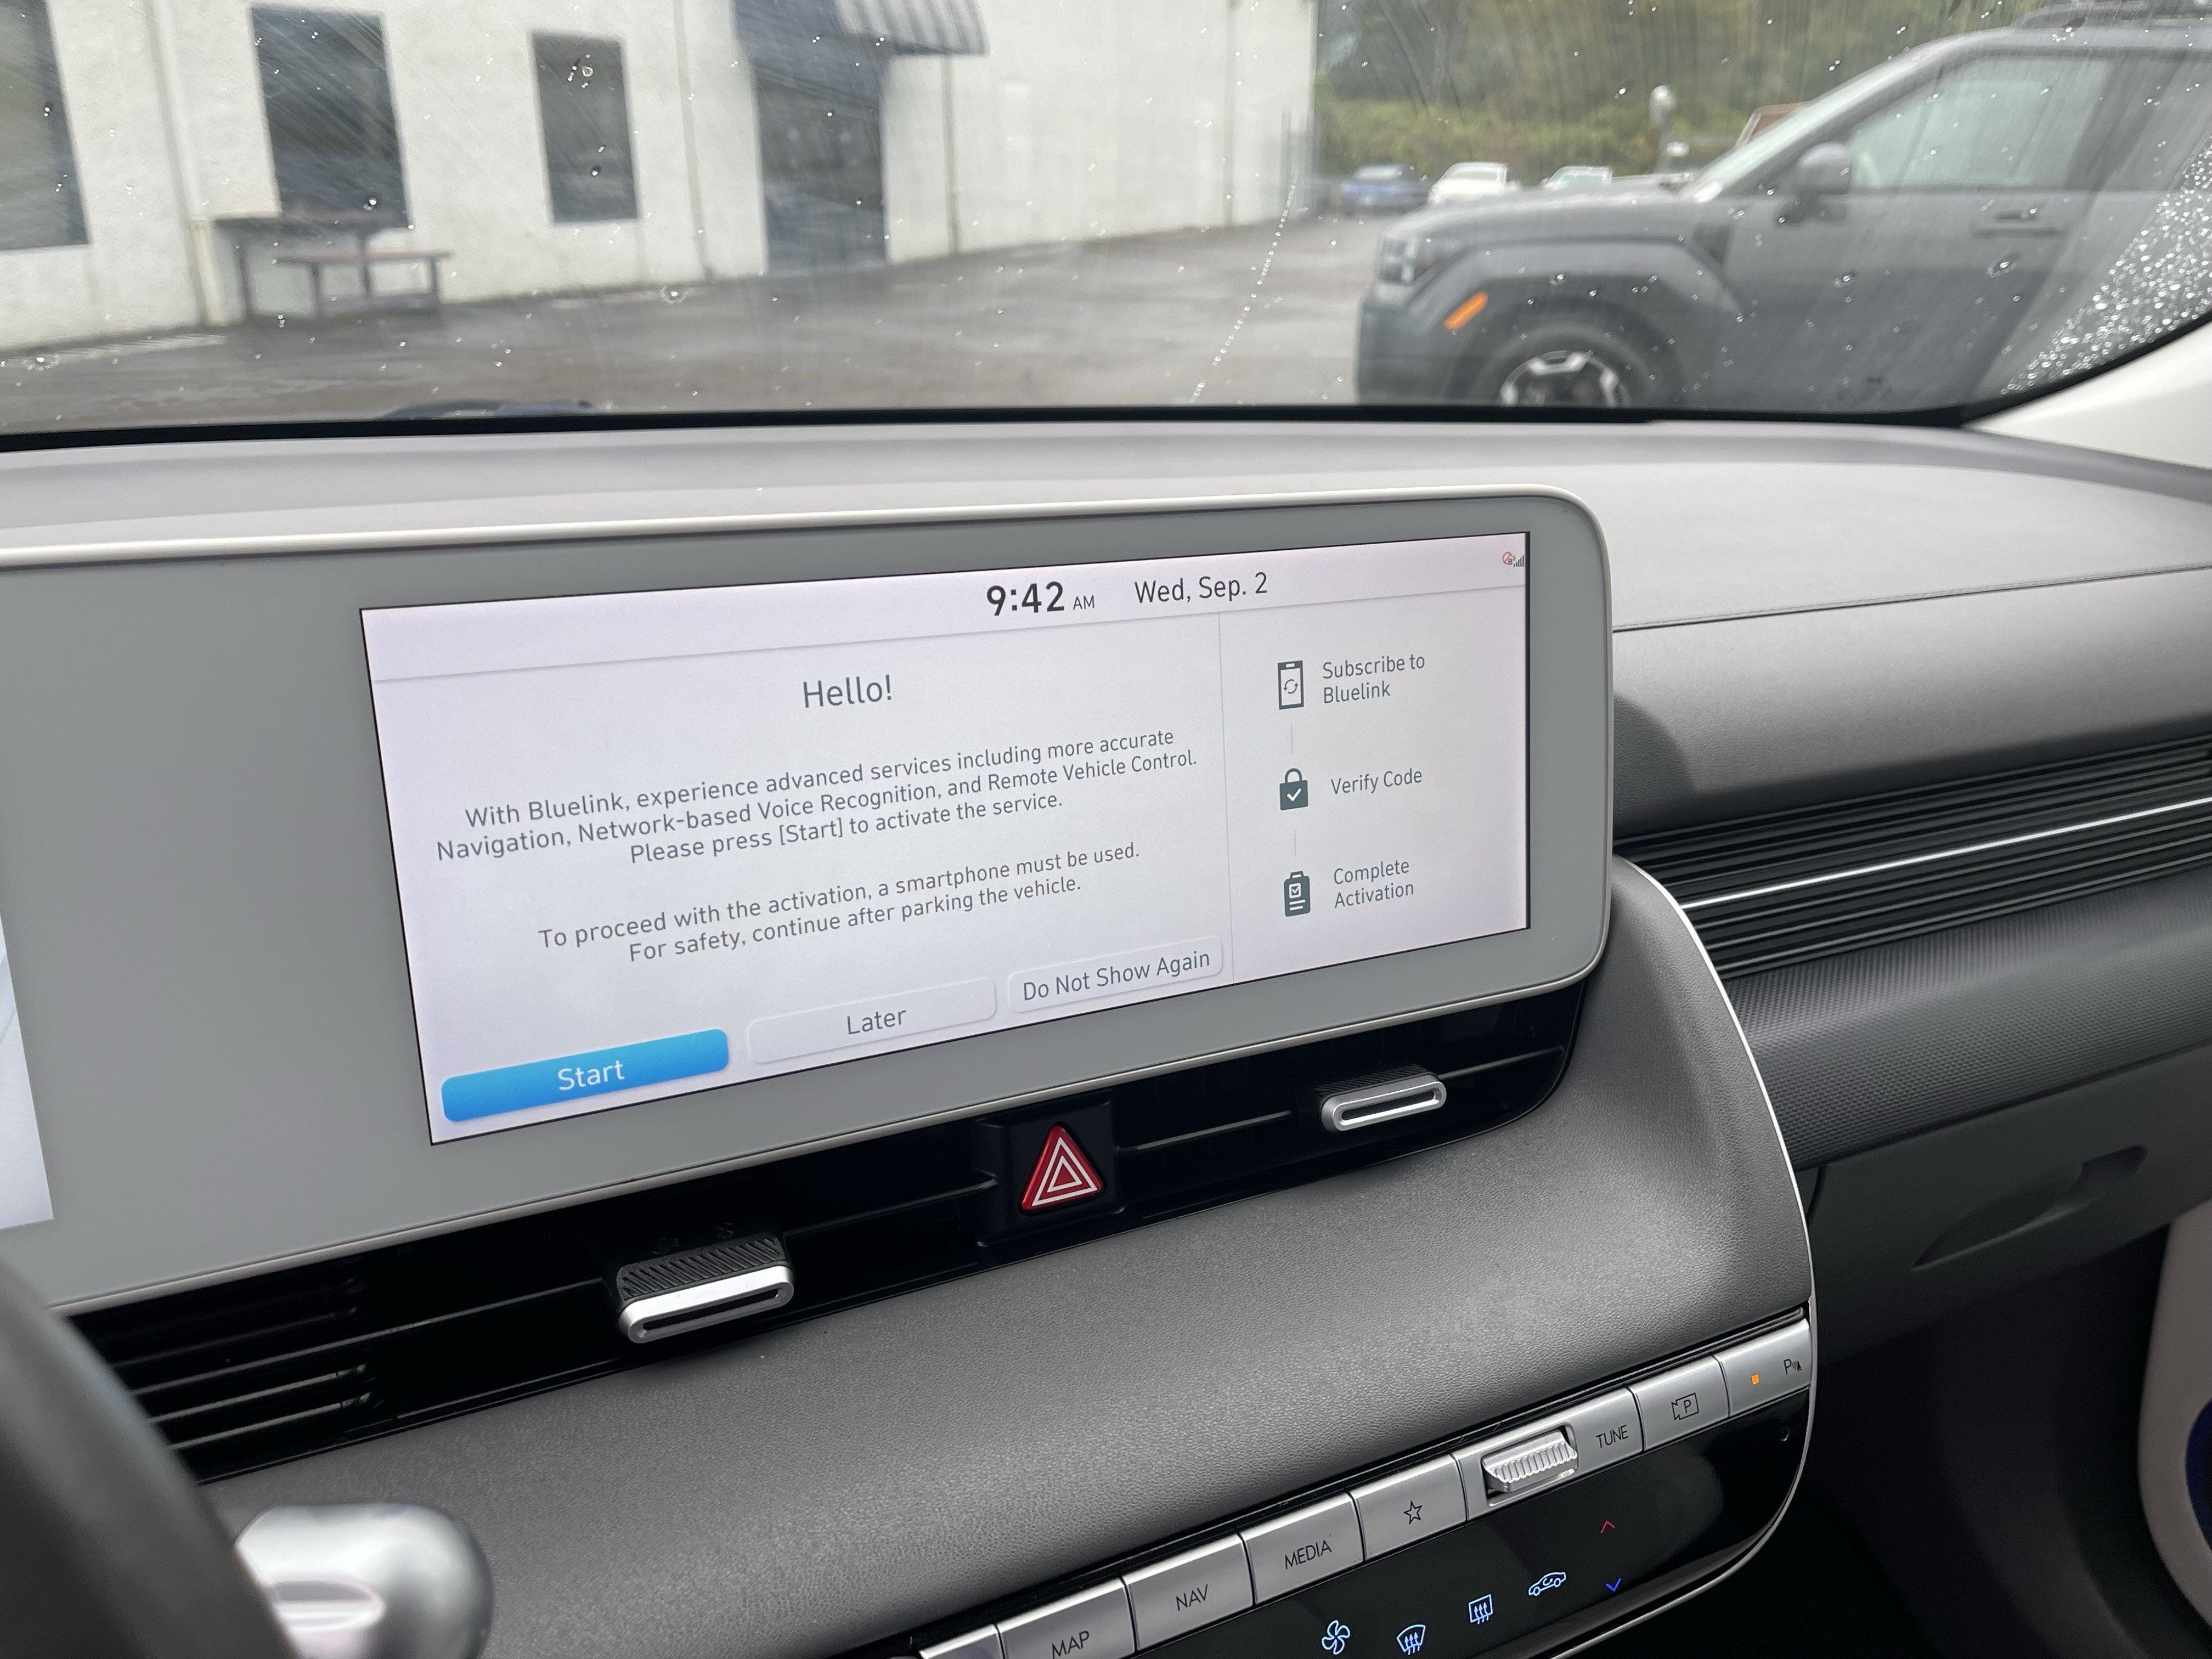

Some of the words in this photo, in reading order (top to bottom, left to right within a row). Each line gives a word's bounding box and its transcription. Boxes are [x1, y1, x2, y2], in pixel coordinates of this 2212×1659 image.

[986, 581, 1065, 616] 9:42
[1073, 595, 1095, 611] AM
[1134, 578, 1191, 603] Wed,
[1199, 575, 1246, 602] Sep.
[1255, 572, 1267, 594] 2
[1323, 655, 1405, 679] Subscribe
[1409, 654, 1425, 670] to
[803, 674, 891, 708] Hello!
[1323, 680, 1391, 704] Bluelink
[465, 804, 520, 828] With
[528, 792, 630, 821] Bluelink,
[637, 781, 758, 809] experience
[766, 764, 864, 793] advanced
[871, 757, 951, 780] services
[957, 746, 1041, 770] including
[1048, 741, 1094, 759] more
[1099, 730, 1173, 753] accurate
[1330, 773, 1379, 795] Verify
[1383, 768, 1423, 788] Code
[437, 831, 571, 861] Navigation,
[578, 803, 751, 843] Network-based
[757, 798, 814, 820] Voice
[821, 783, 941, 813] Recognition,
[947, 775, 981, 796] and
[988, 768, 1058, 791] Remote
[1062, 759, 1126, 781] Vehicle
[1131, 749, 1197, 772] Control.
[630, 841, 704, 864] Please
[712, 832, 772, 857] press
[779, 817, 843, 846] [Start]
[849, 818, 869, 834] to
[876, 807, 951, 831] activate
[956, 802, 986, 820] the
[992, 793, 1062, 815] service.
[1334, 860, 1409, 886] Complete
[538, 929, 567, 948] To
[575, 912, 667, 948] proceed
[673, 905, 720, 928] with
[726, 900, 761, 920] the
[769, 885, 872, 913] activation,
[878, 883, 889, 896] a
[895, 865, 1010, 894] smartphone
[1017, 854, 1062, 875] must
[1067, 851, 1088, 867] be
[1093, 842, 1139, 864] used.
[1334, 882, 1414, 909] Activation
[629, 943, 667, 962] For
[674, 930, 746, 955] safety,
[752, 916, 840, 942] continue
[848, 907, 895, 927] after
[901, 894, 973, 922] parking
[978, 888, 1008, 906] the
[1013, 876, 1081, 900] vehicle.
[1023, 981, 1049, 1001] Do
[1056, 972, 1091, 995] Not
[1096, 964, 1150, 987] Show
[1156, 950, 1210, 978] Again
[847, 1010, 907, 1035] Later
[557, 1059, 625, 1091] Start
[1595, 1424, 1629, 1448] TUNE
[1284, 1539, 1333, 1570] MEDIA
[1175, 1584, 1209, 1611] NAV
[1052, 1630, 1090, 1659] MAP
